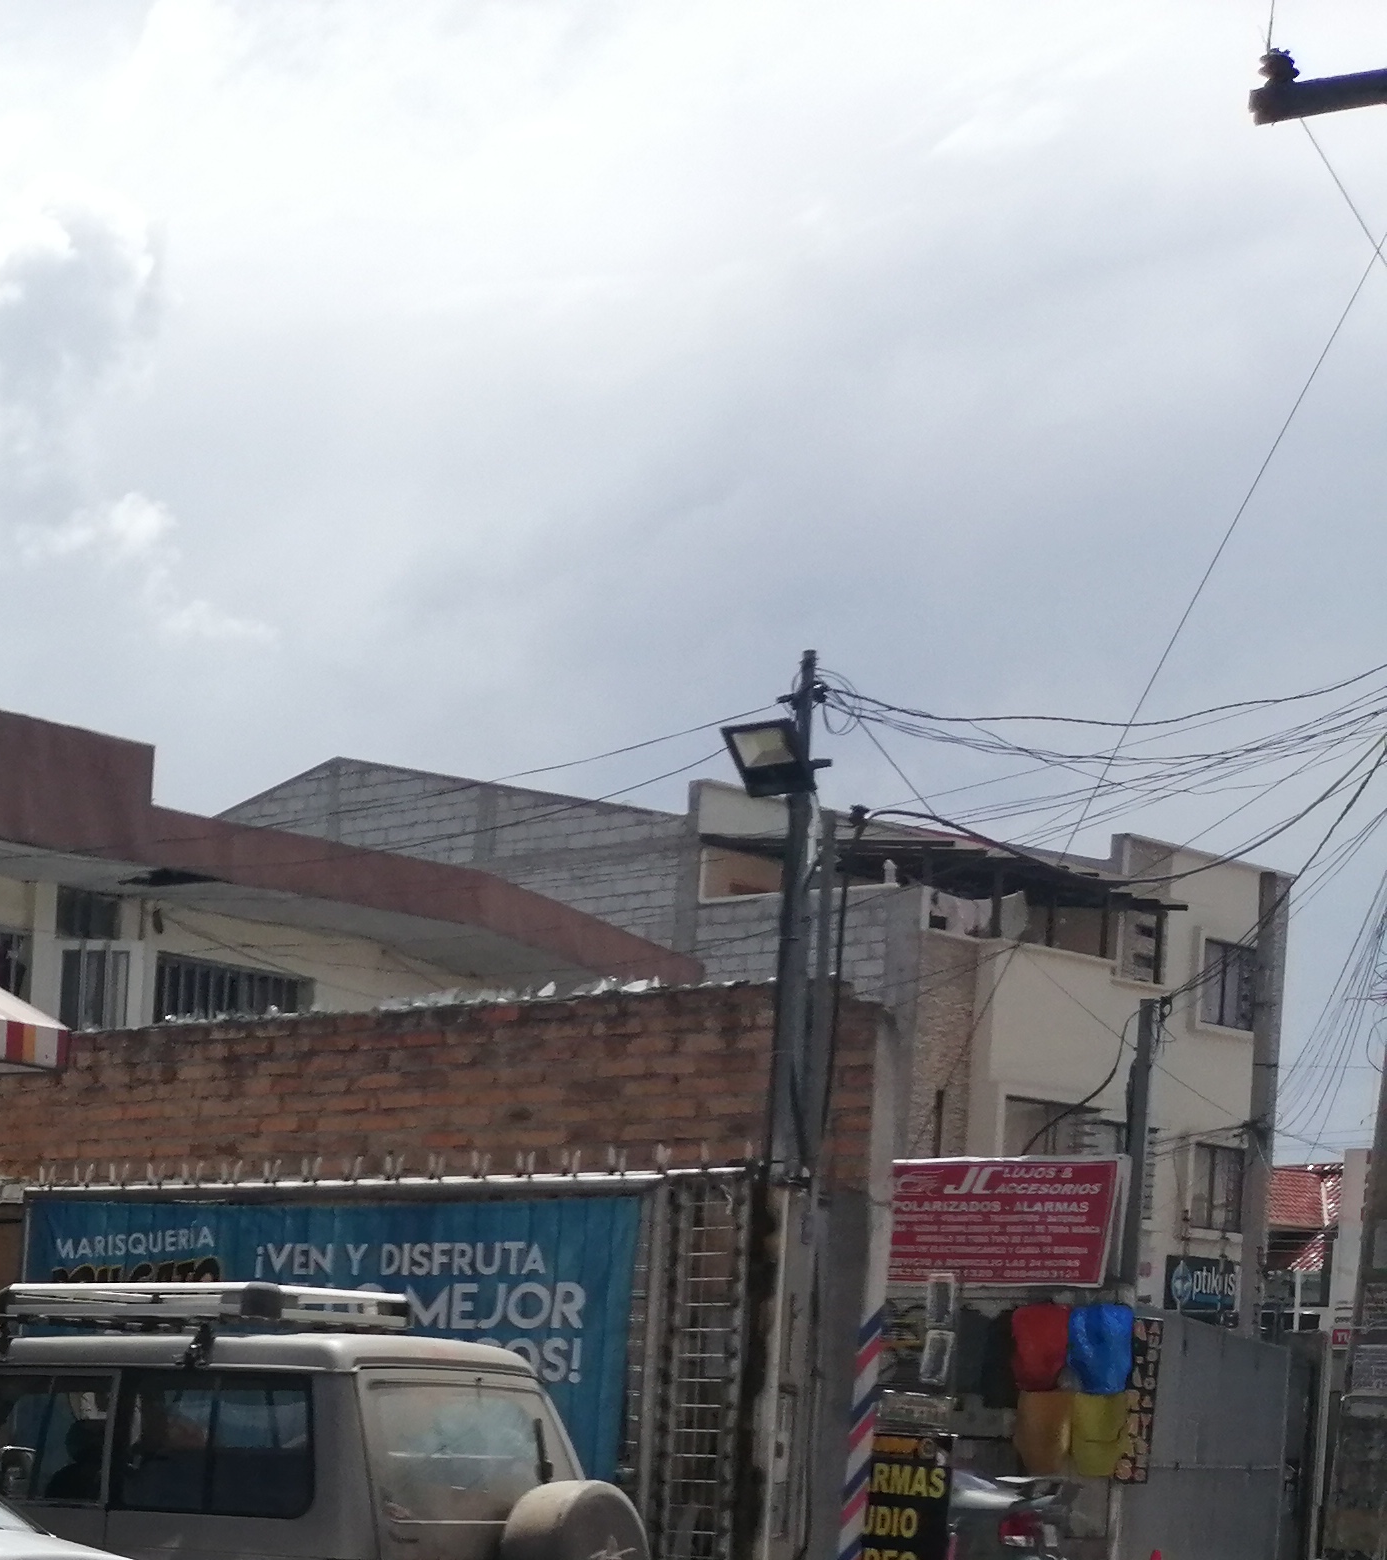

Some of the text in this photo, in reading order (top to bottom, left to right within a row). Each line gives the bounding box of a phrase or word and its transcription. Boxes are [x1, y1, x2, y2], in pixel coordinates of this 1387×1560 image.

[943, 1167, 1003, 1194] JC
[1003, 1167, 1056, 1178] LUJOS
[995, 1183, 1103, 1195] ACCESORIOS
[1014, 1201, 1089, 1213] ALARMAS
[346, 1243, 369, 1277] Y
[379, 1240, 547, 1276] DISFRUTA
[405, 1281, 587, 1330] MEJOR
[869, 1462, 945, 1499] RMAS
